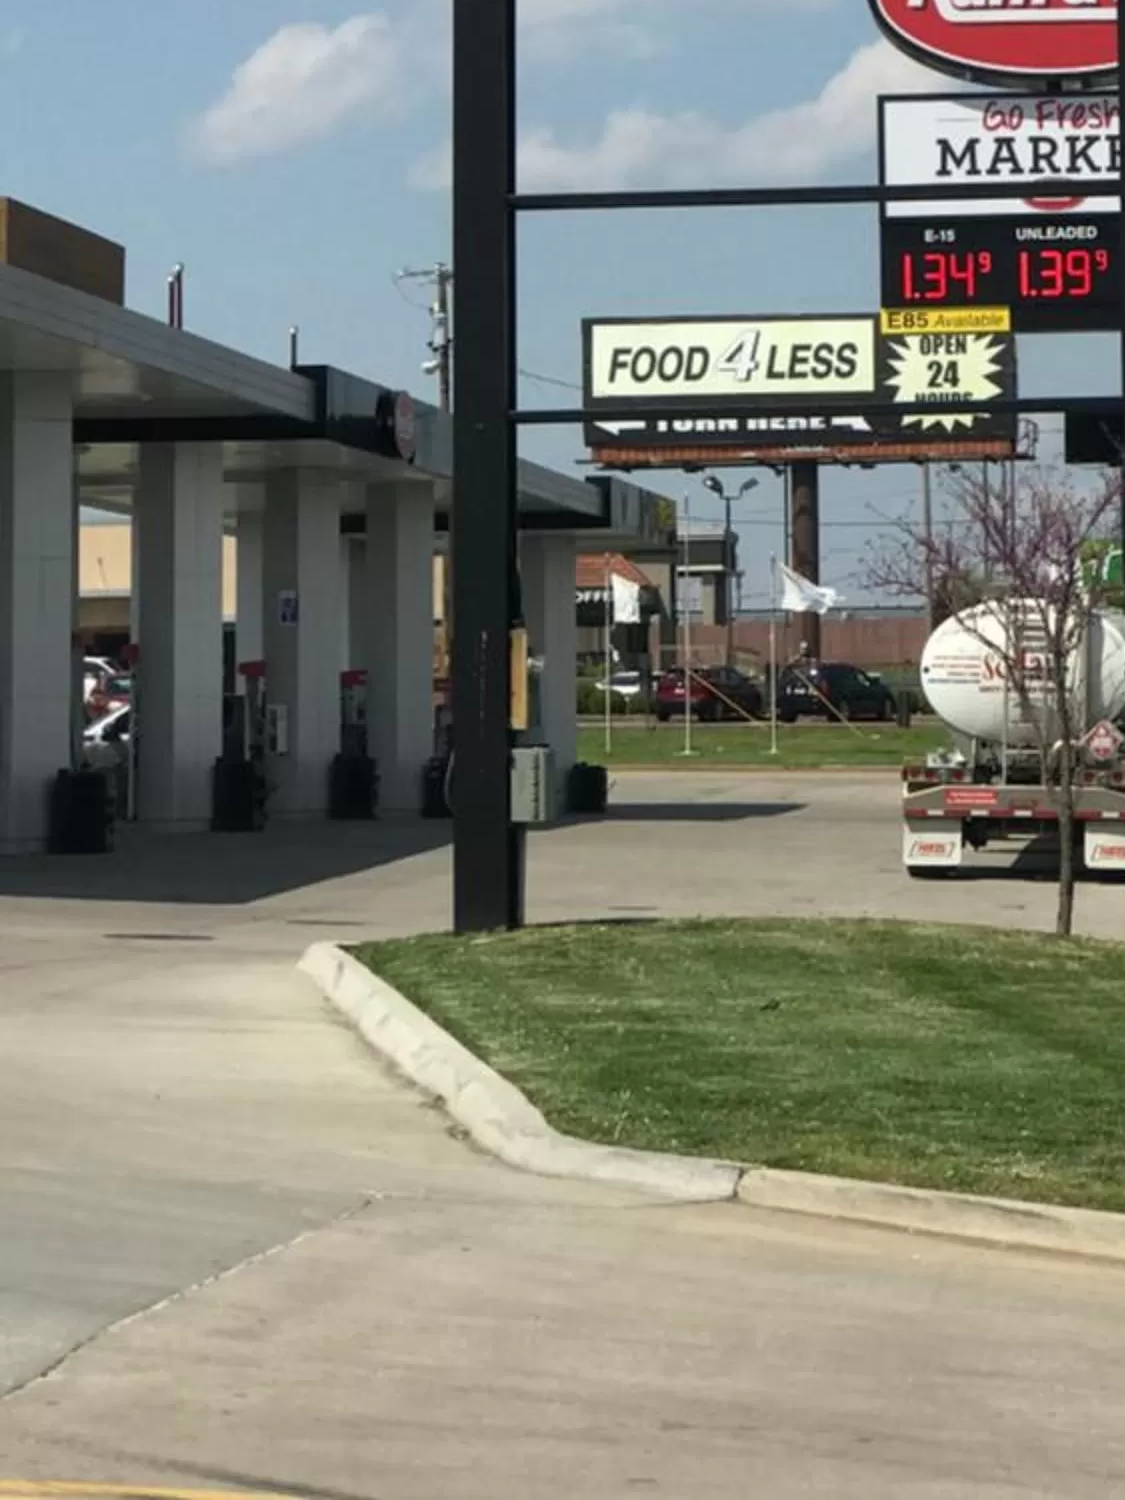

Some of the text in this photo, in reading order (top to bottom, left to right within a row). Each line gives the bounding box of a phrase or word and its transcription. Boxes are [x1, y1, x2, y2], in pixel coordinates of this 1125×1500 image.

[981, 97, 1120, 132] Go Fresh
[935, 133, 1121, 177] MARK
[923, 228, 956, 243] E-15
[1015, 225, 1098, 242] UNLEADED
[888, 309, 1004, 330] E85 Available
[608, 329, 859, 384] FOOD 4 LESS
[919, 334, 968, 356] OPEN
[926, 361, 960, 388] 24
